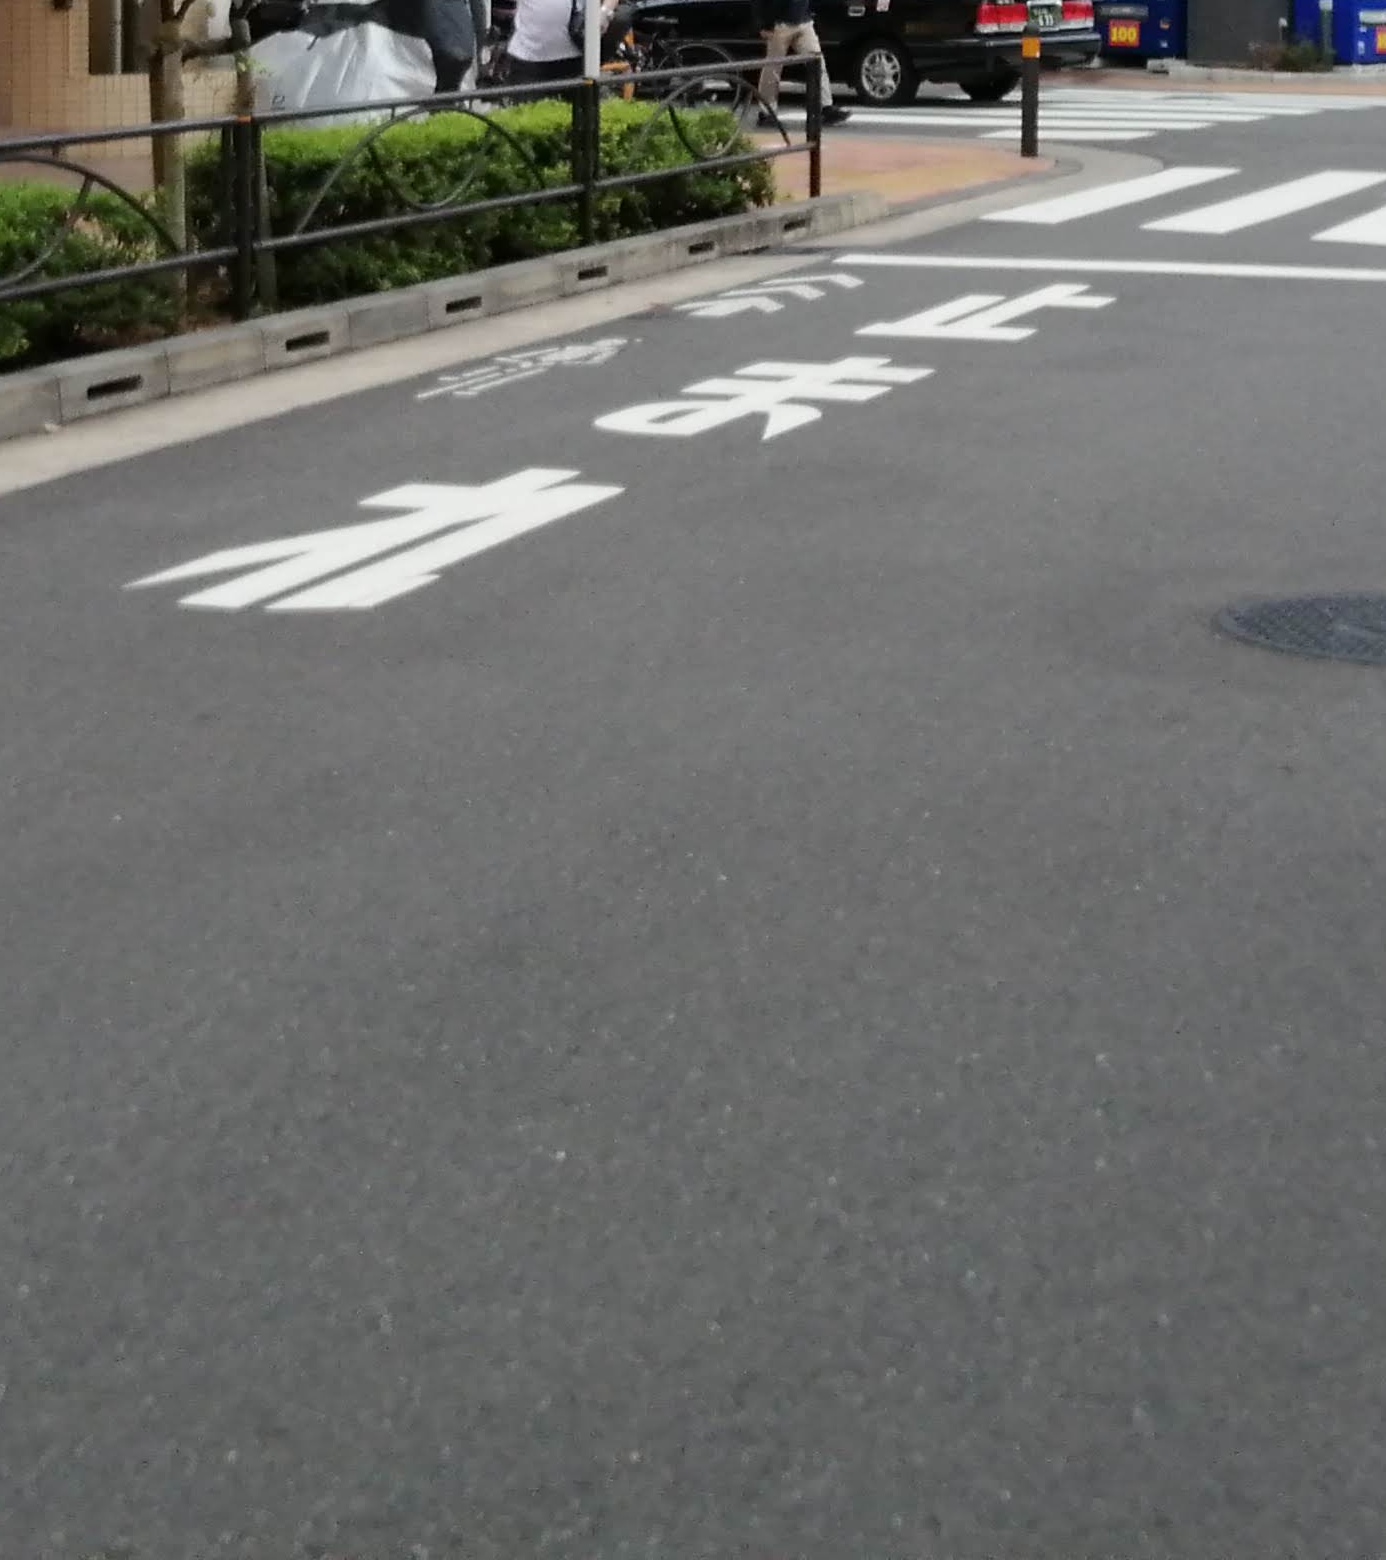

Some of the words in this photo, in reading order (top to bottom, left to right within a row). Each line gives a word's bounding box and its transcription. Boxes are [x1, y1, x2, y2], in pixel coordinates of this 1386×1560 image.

[1111, 25, 1137, 44] 100
[123, 283, 1116, 612] 止まれ
